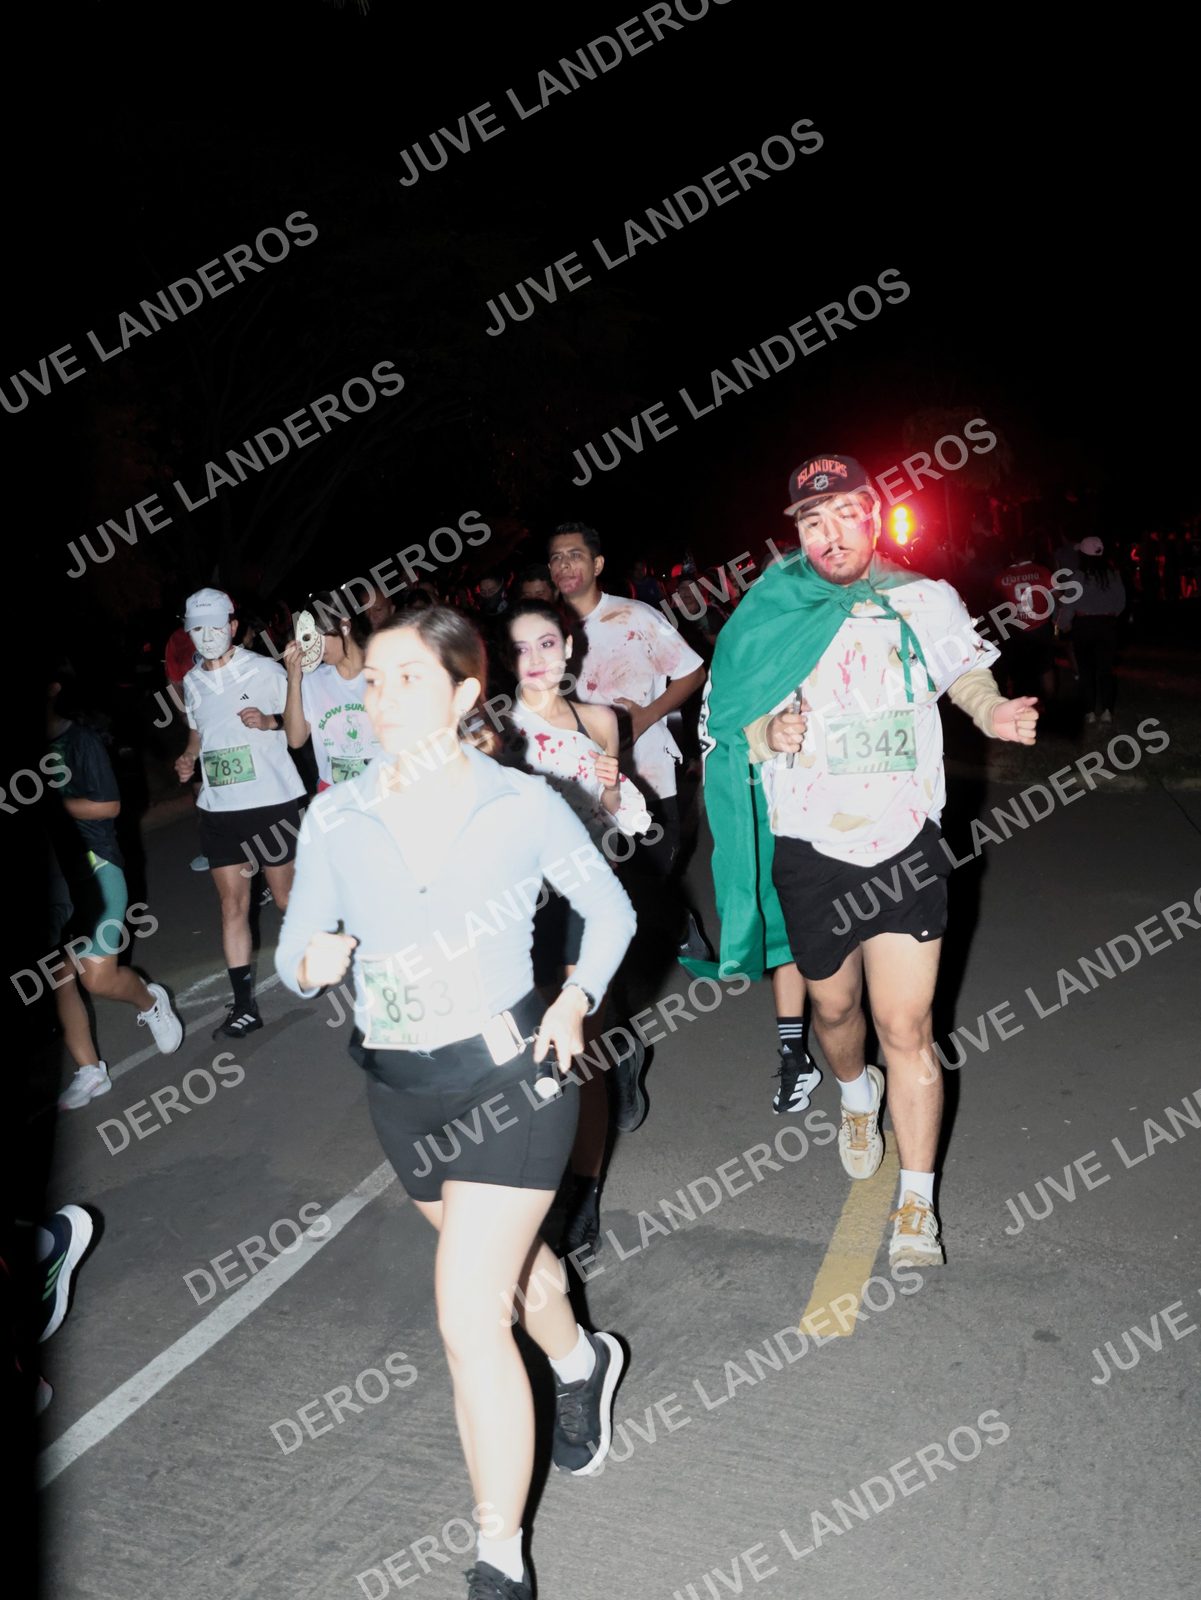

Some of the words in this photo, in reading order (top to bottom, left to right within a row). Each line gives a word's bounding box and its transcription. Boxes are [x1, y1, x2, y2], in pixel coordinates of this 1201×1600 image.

[797, 459, 848, 489] ISLANDERS
[318, 705, 342, 730] SLOW
[344, 703, 367, 713] SUN
[835, 728, 909, 759] 1342
[211, 758, 243, 777] 783
[382, 980, 454, 1023] 853
